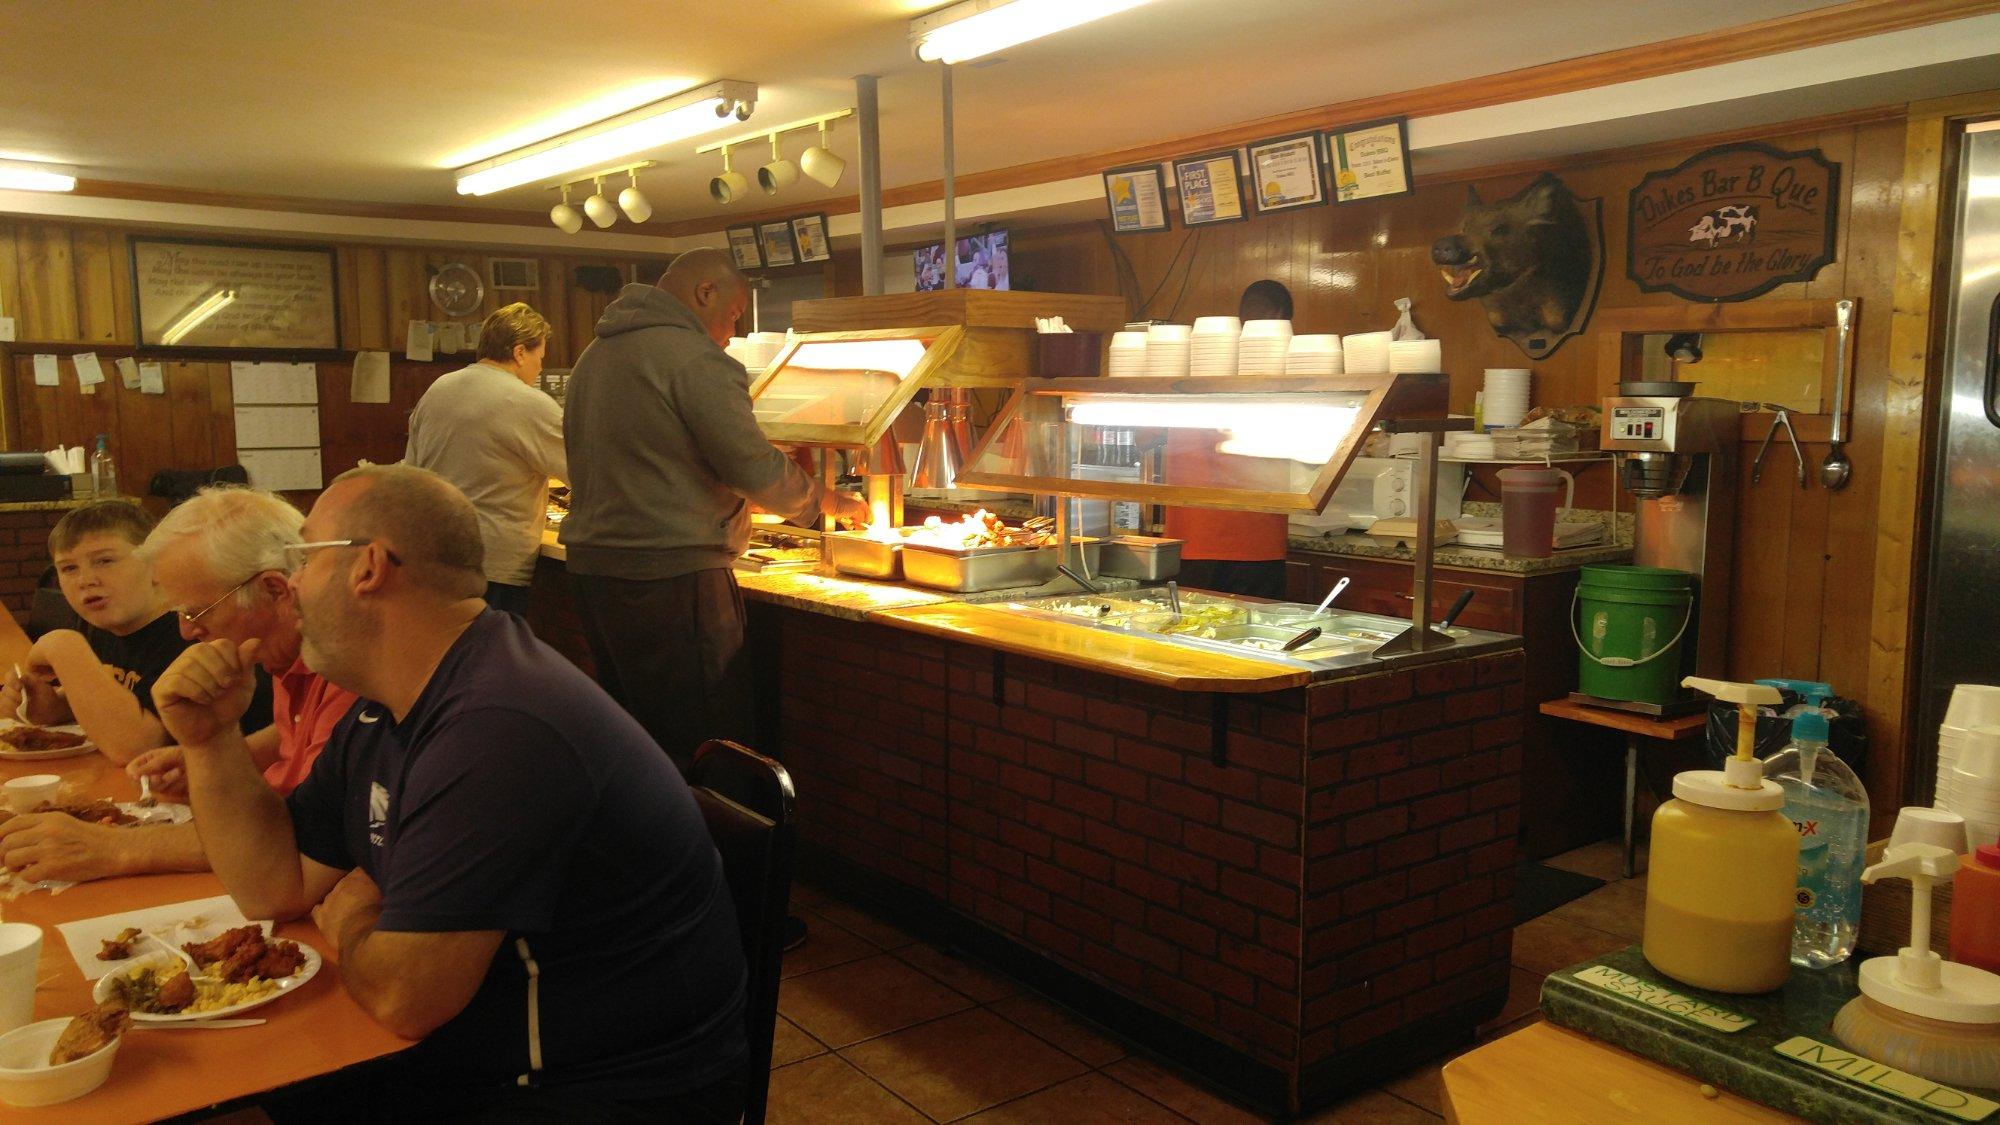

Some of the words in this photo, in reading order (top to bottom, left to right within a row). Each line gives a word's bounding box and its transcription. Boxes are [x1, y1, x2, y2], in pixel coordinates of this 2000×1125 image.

[1184, 178, 1209, 190] PLACE
[1638, 186, 1695, 222] Dukes
[1700, 168, 1740, 198] Bar
[1746, 164, 1765, 193] B
[1771, 166, 1819, 211] Que
[1643, 255, 1666, 279] To
[1671, 252, 1708, 278] God
[1710, 254, 1732, 276] be
[1736, 252, 1764, 273] the
[1766, 248, 1813, 274] Glory
[1595, 967, 1746, 1024] MUSTARD
[1603, 981, 1710, 1018] SAUCE
[1797, 1044, 1969, 1109] MILD
